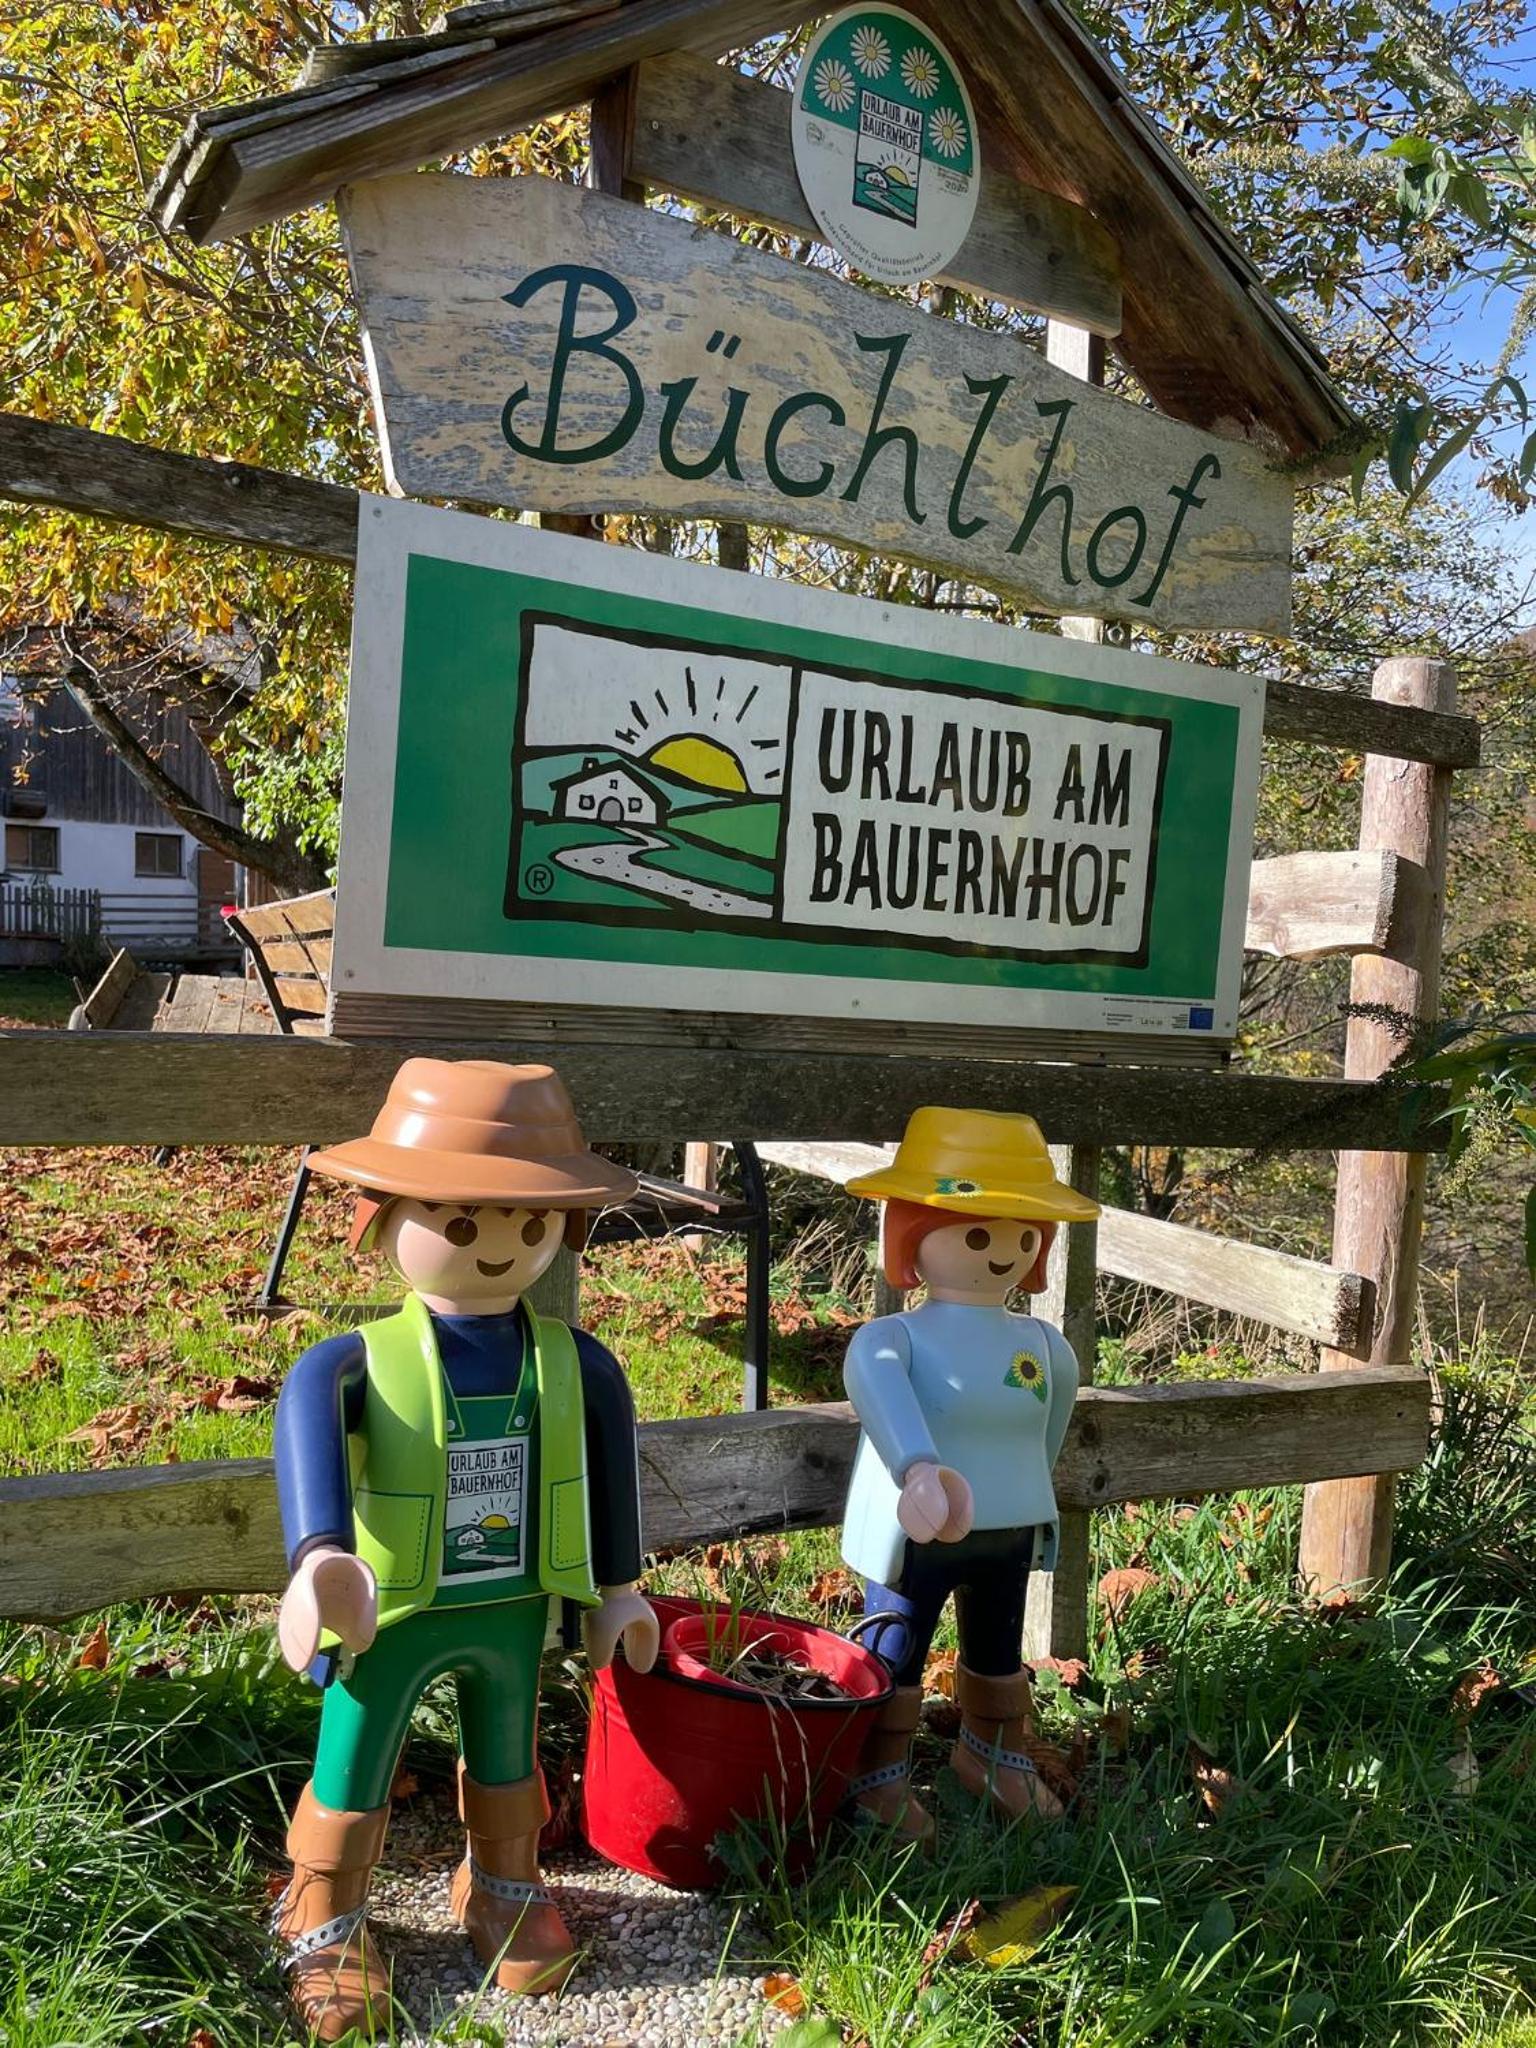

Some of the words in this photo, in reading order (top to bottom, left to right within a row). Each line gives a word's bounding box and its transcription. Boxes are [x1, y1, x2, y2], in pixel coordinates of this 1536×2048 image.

[863, 93, 901, 124] URLAUB
[904, 110, 920, 131] AM
[862, 114, 919, 151] BAUERNHOF
[817, 707, 1032, 818] URLAUB
[1055, 742, 1132, 829] AM
[809, 812, 1132, 927] BAUERNHOF
[451, 1452, 497, 1471] URLAUB
[501, 1450, 519, 1467] AM
[451, 1471, 518, 1495] BAUERNHOF
